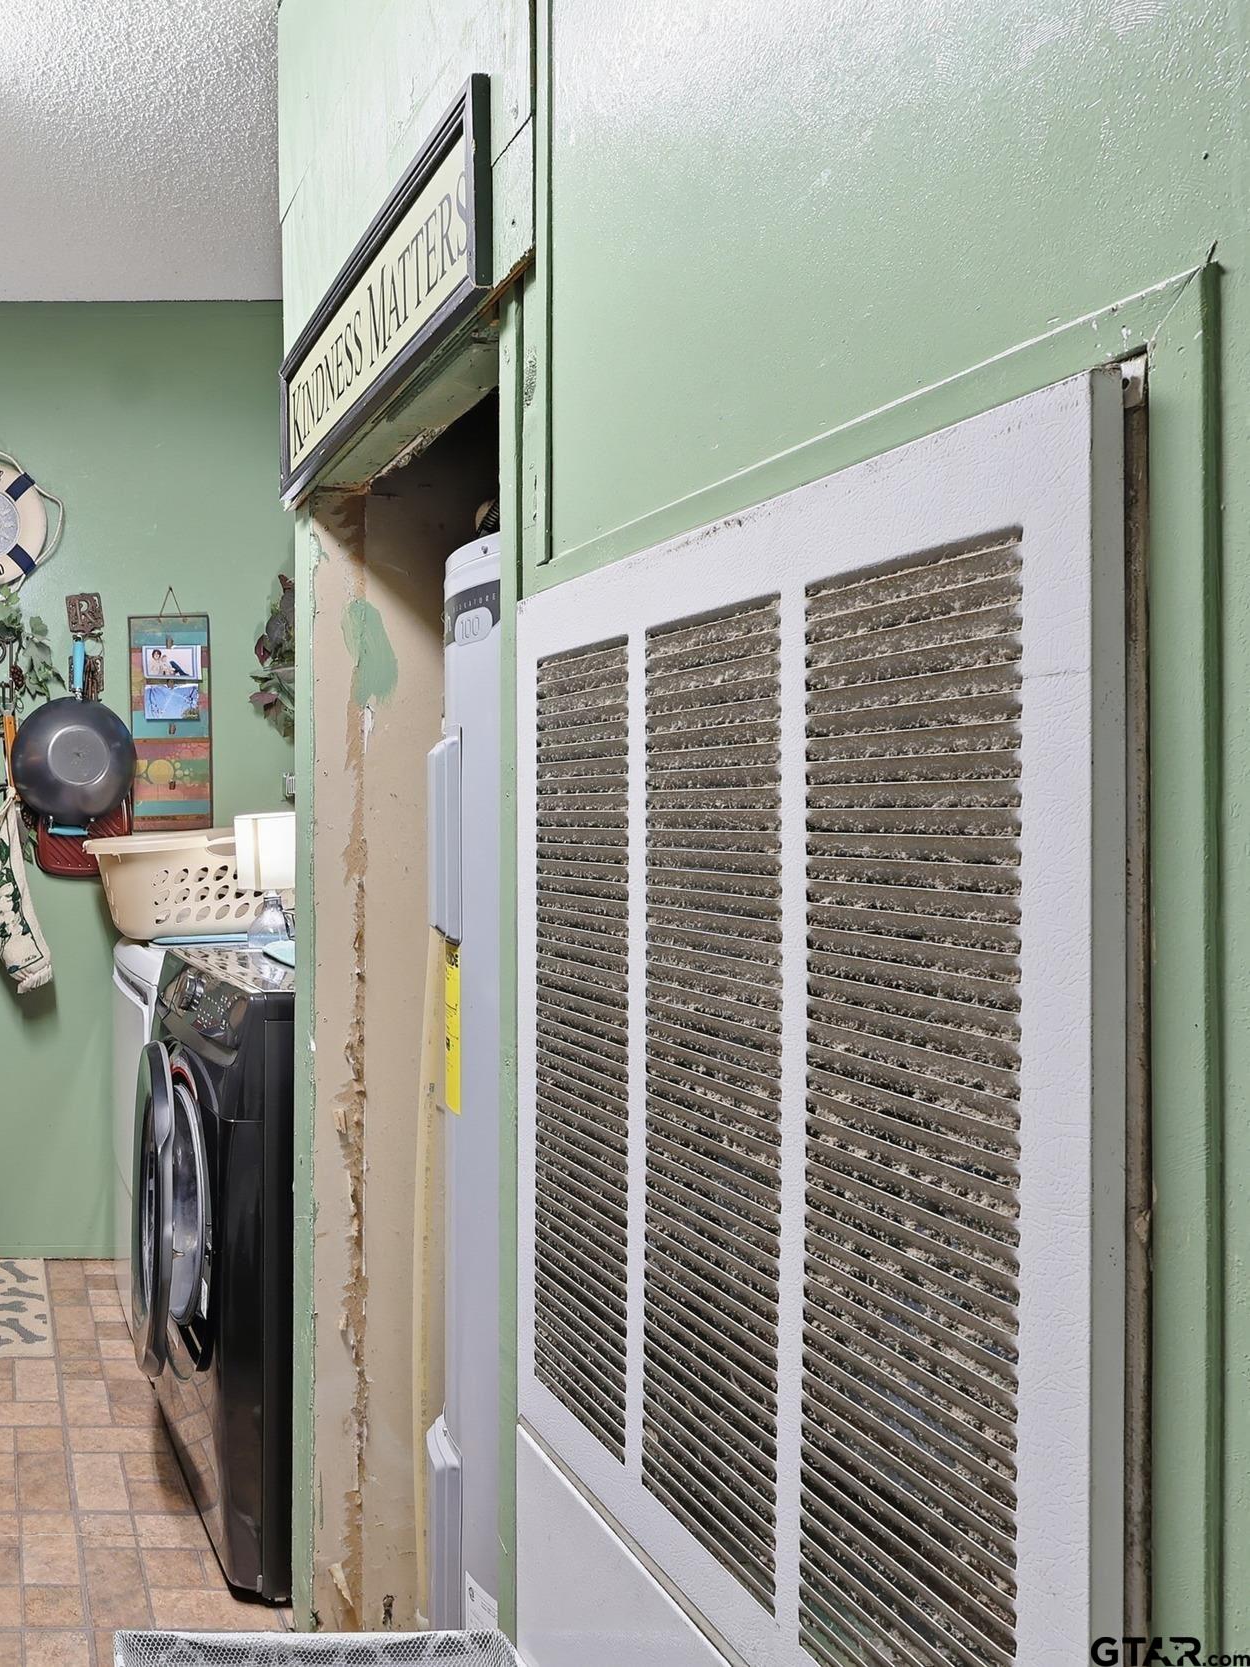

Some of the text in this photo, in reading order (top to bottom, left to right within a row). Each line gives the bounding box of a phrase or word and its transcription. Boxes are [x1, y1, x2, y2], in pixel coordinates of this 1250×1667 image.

[292, 171, 471, 457] KINDNESS MATTERS
[75, 599, 96, 625] R
[460, 615, 480, 640] 100
